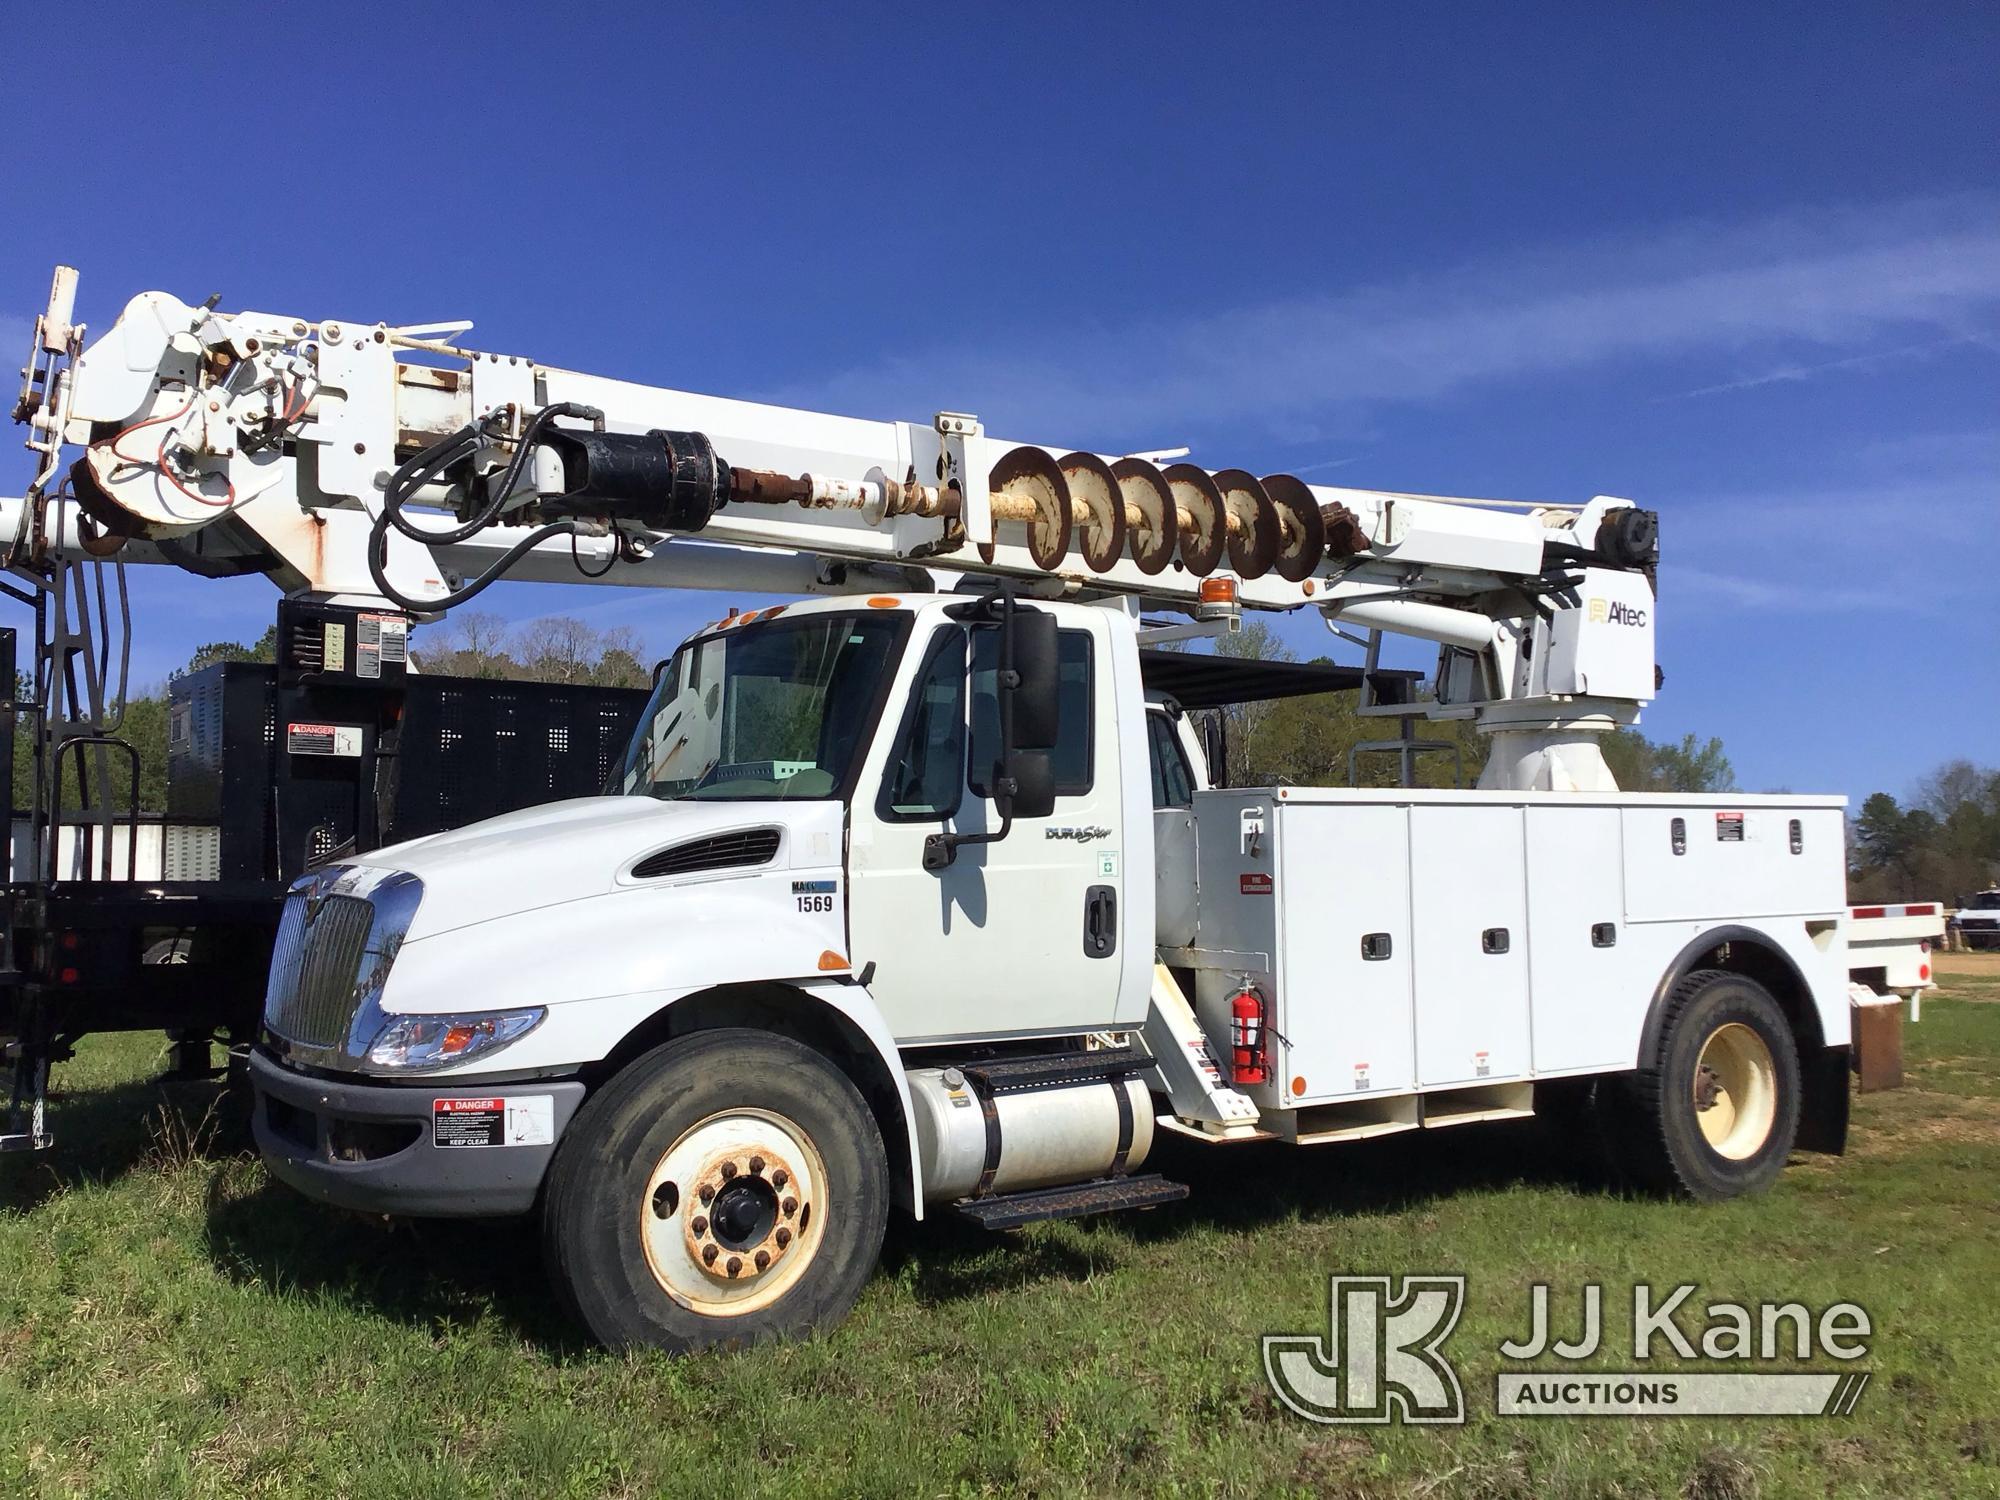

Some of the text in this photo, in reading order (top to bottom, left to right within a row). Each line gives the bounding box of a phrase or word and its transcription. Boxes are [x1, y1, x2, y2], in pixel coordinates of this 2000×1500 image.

[1607, 601, 1647, 628] Altec
[301, 726, 335, 735] DANGER
[797, 896, 832, 912] 1569
[455, 1101, 495, 1110] DANGER
